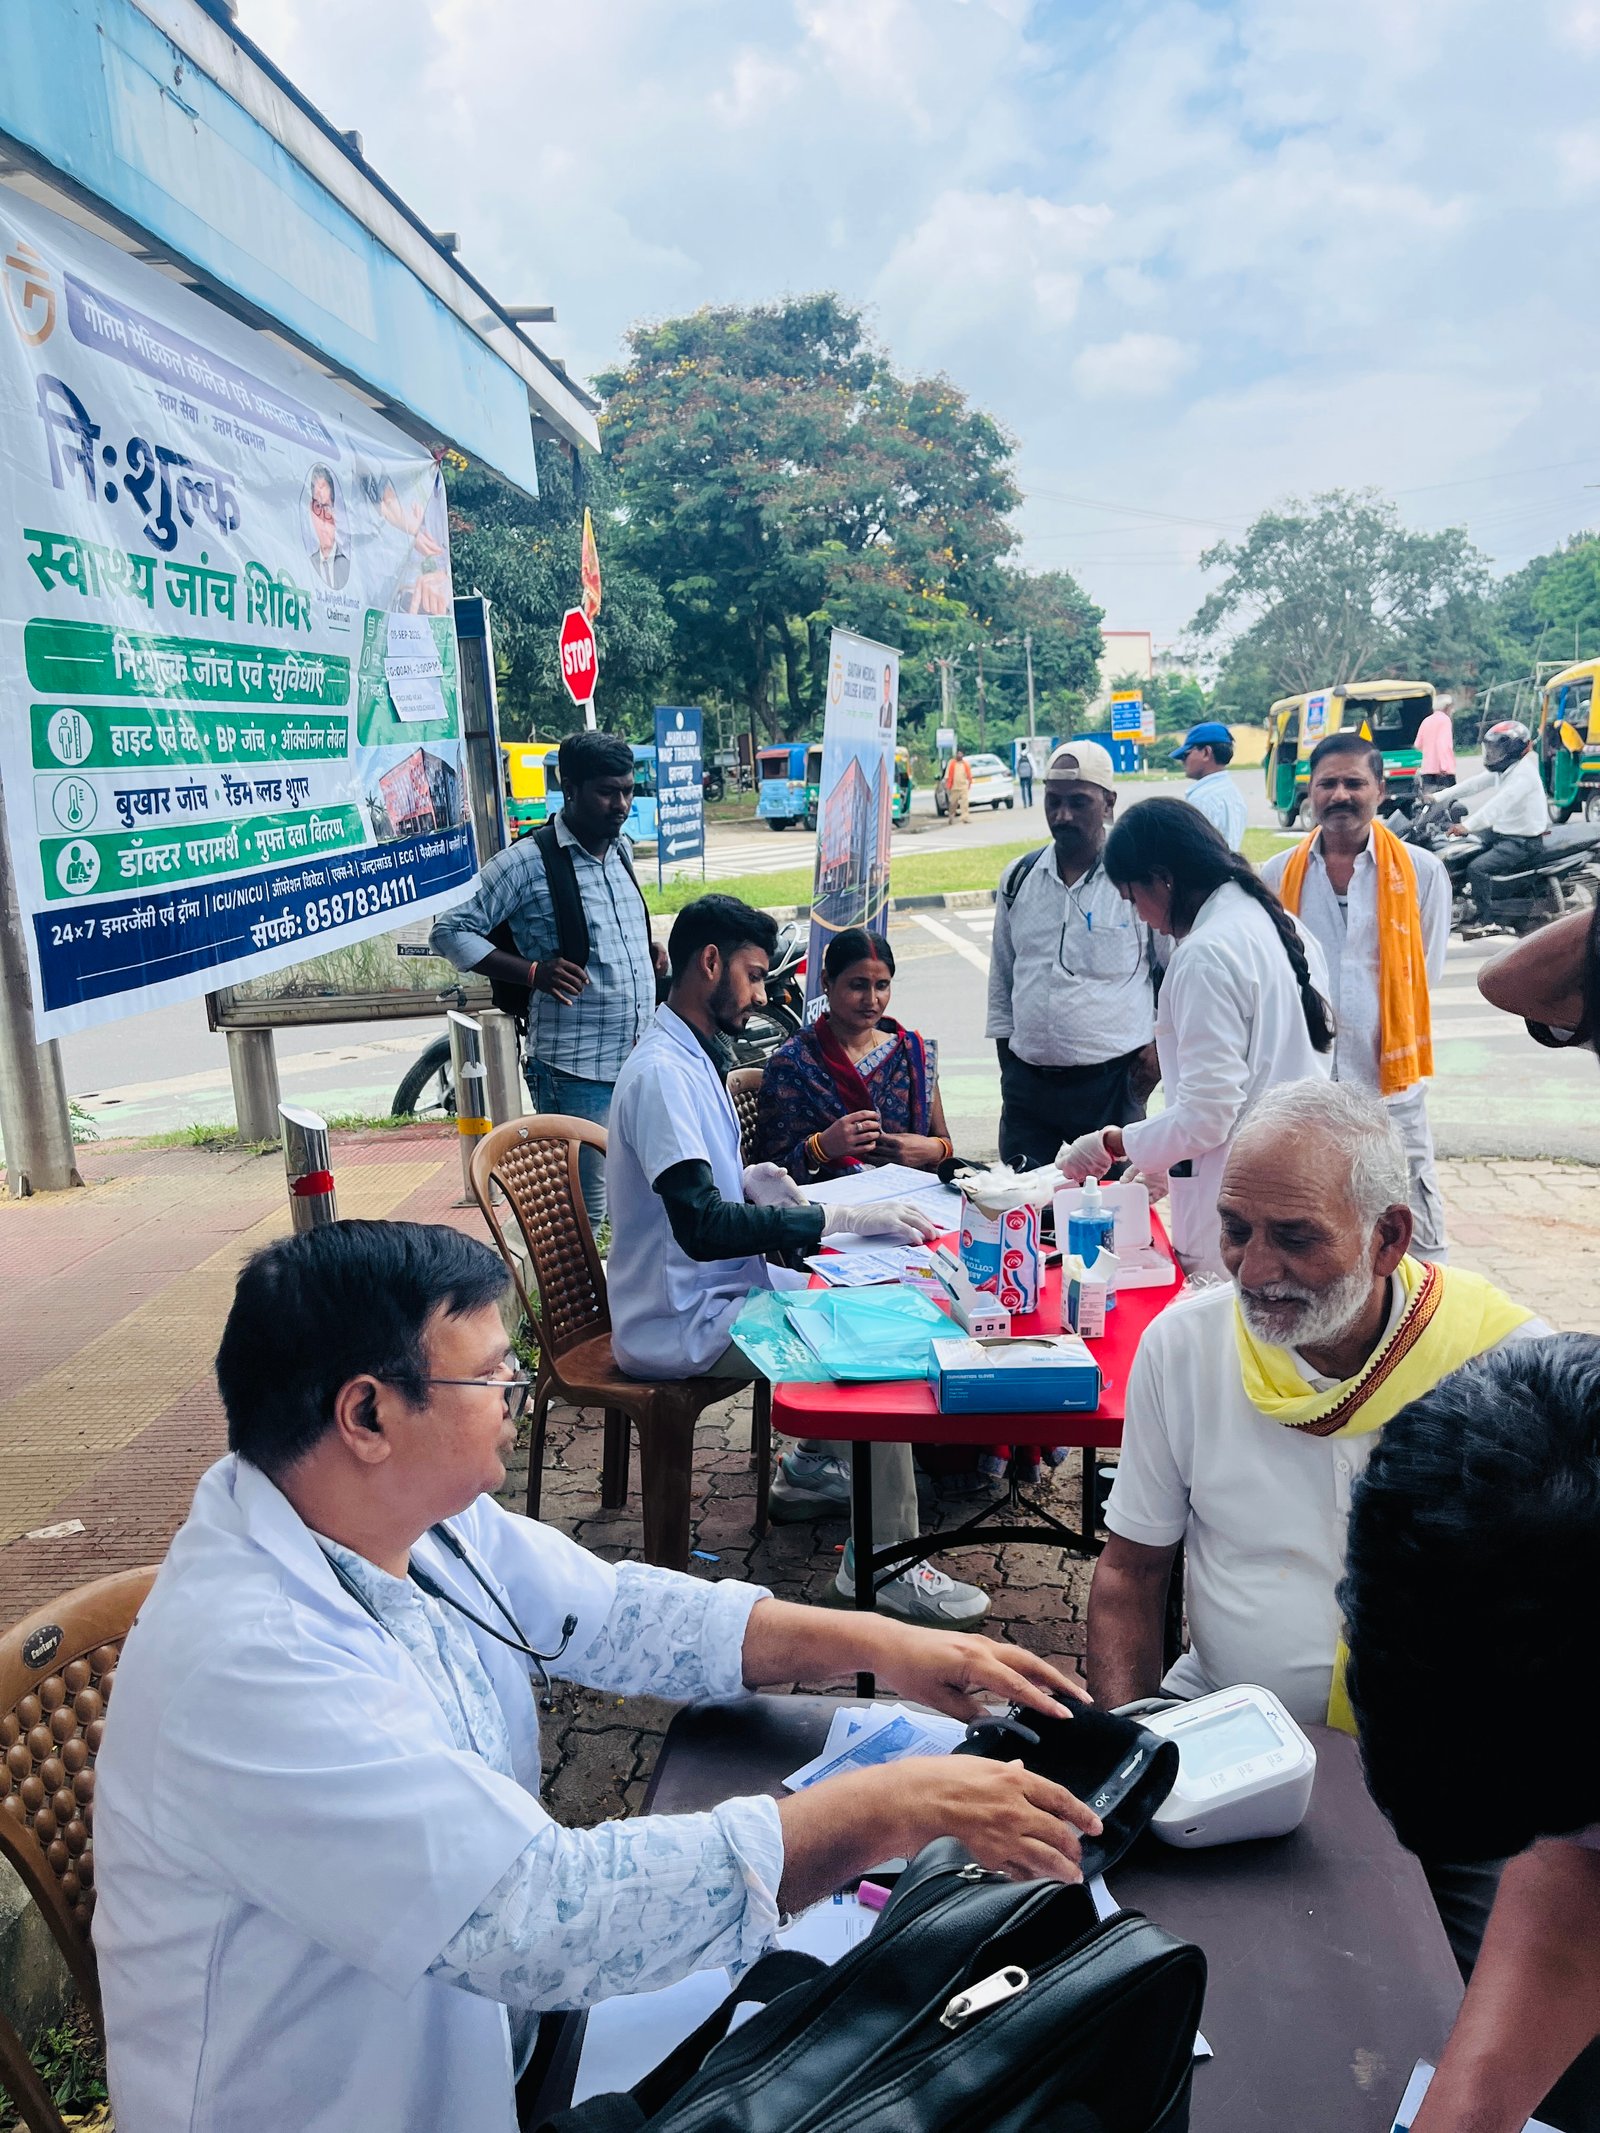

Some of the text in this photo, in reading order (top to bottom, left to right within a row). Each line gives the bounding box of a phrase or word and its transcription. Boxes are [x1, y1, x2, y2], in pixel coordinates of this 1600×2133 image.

[81, 295, 129, 347] गौतम
[128, 318, 186, 377] मेडिकल
[184, 354, 231, 400] कॉलेज
[229, 378, 252, 411] एवं
[155, 389, 266, 451] उत्तम सेवा उत्तम देखभाल
[24, 528, 312, 633] स्वास्थ्य जांच शिविर
[192, 648, 234, 688] जांच
[237, 652, 264, 694] एवं
[564, 638, 592, 676] STOP
[109, 718, 346, 758] हाइट एवं वेट BP जांच ऑक्सीजन लेवल
[114, 774, 311, 828] बुखार जांच रैंडम ब्लड शुगर
[118, 814, 345, 877] डॉक्टर परामर्श मुफ्त दवा वितरण
[100, 904, 156, 939] इमरजेंसी
[159, 902, 175, 927] एवं
[177, 897, 201, 925] ट्रॉमा
[212, 884, 263, 913] ICU/NICU
[272, 872, 302, 898] ऑपरेशन
[302, 868, 326, 891] थियेटर
[331, 861, 355, 884] एक्स-रे
[360, 853, 393, 876] अल्ट्रासाउंड
[399, 847, 415, 866] ECG
[250, 874, 418, 949] संपर्क: 8587834111
[1095, 1793, 1110, 1808] OK
